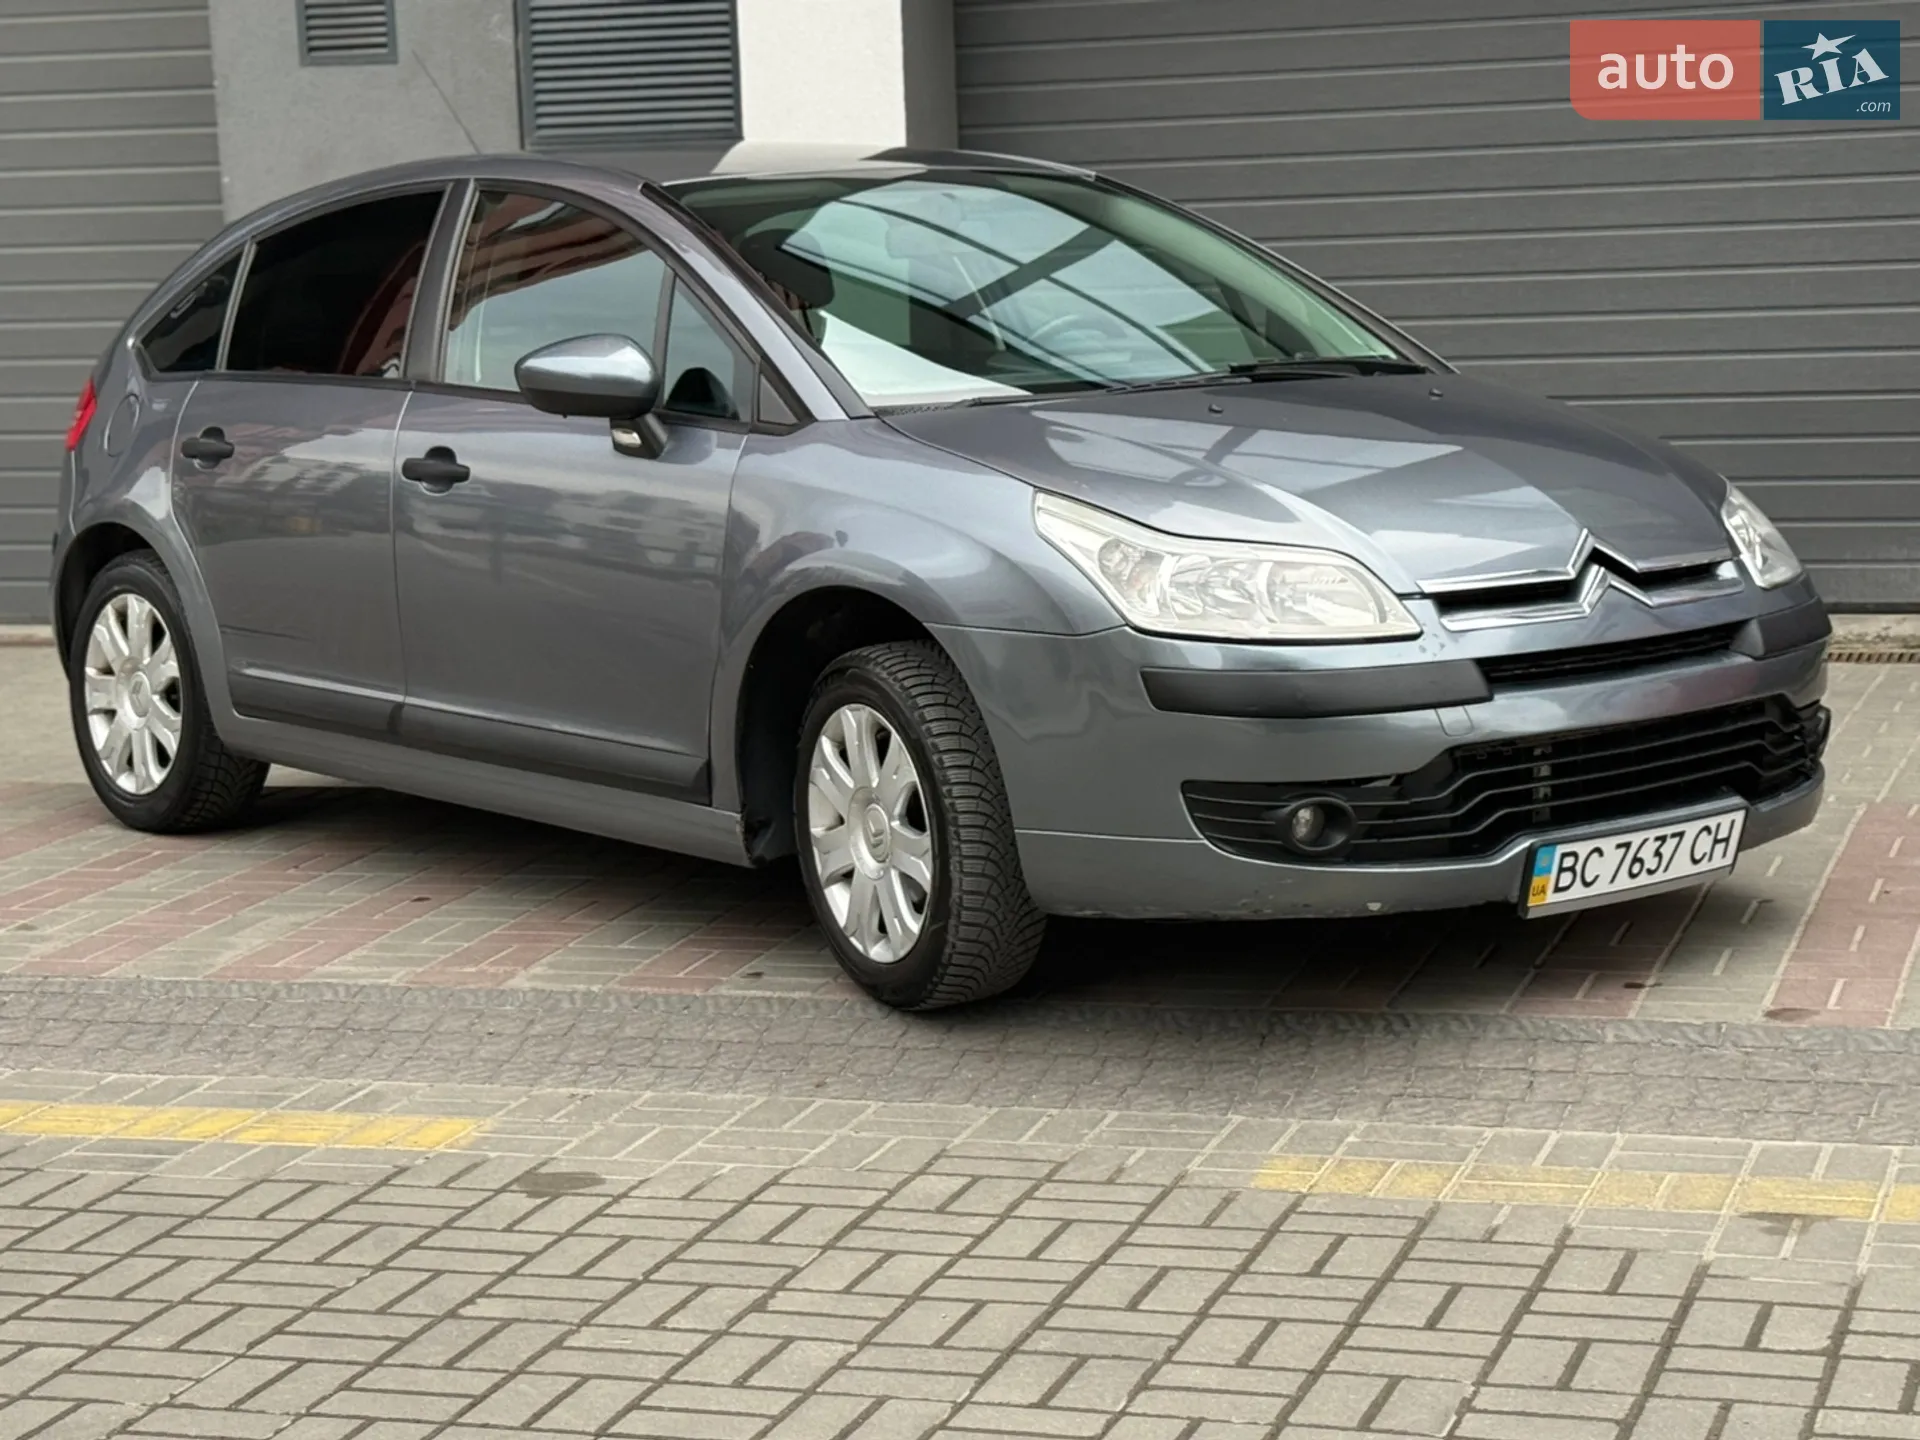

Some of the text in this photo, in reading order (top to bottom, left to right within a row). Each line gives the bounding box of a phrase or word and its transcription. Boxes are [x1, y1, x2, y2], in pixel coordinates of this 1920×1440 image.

[1552, 819, 1736, 894] BC 7637 CH
[1531, 883, 1547, 897] UA
